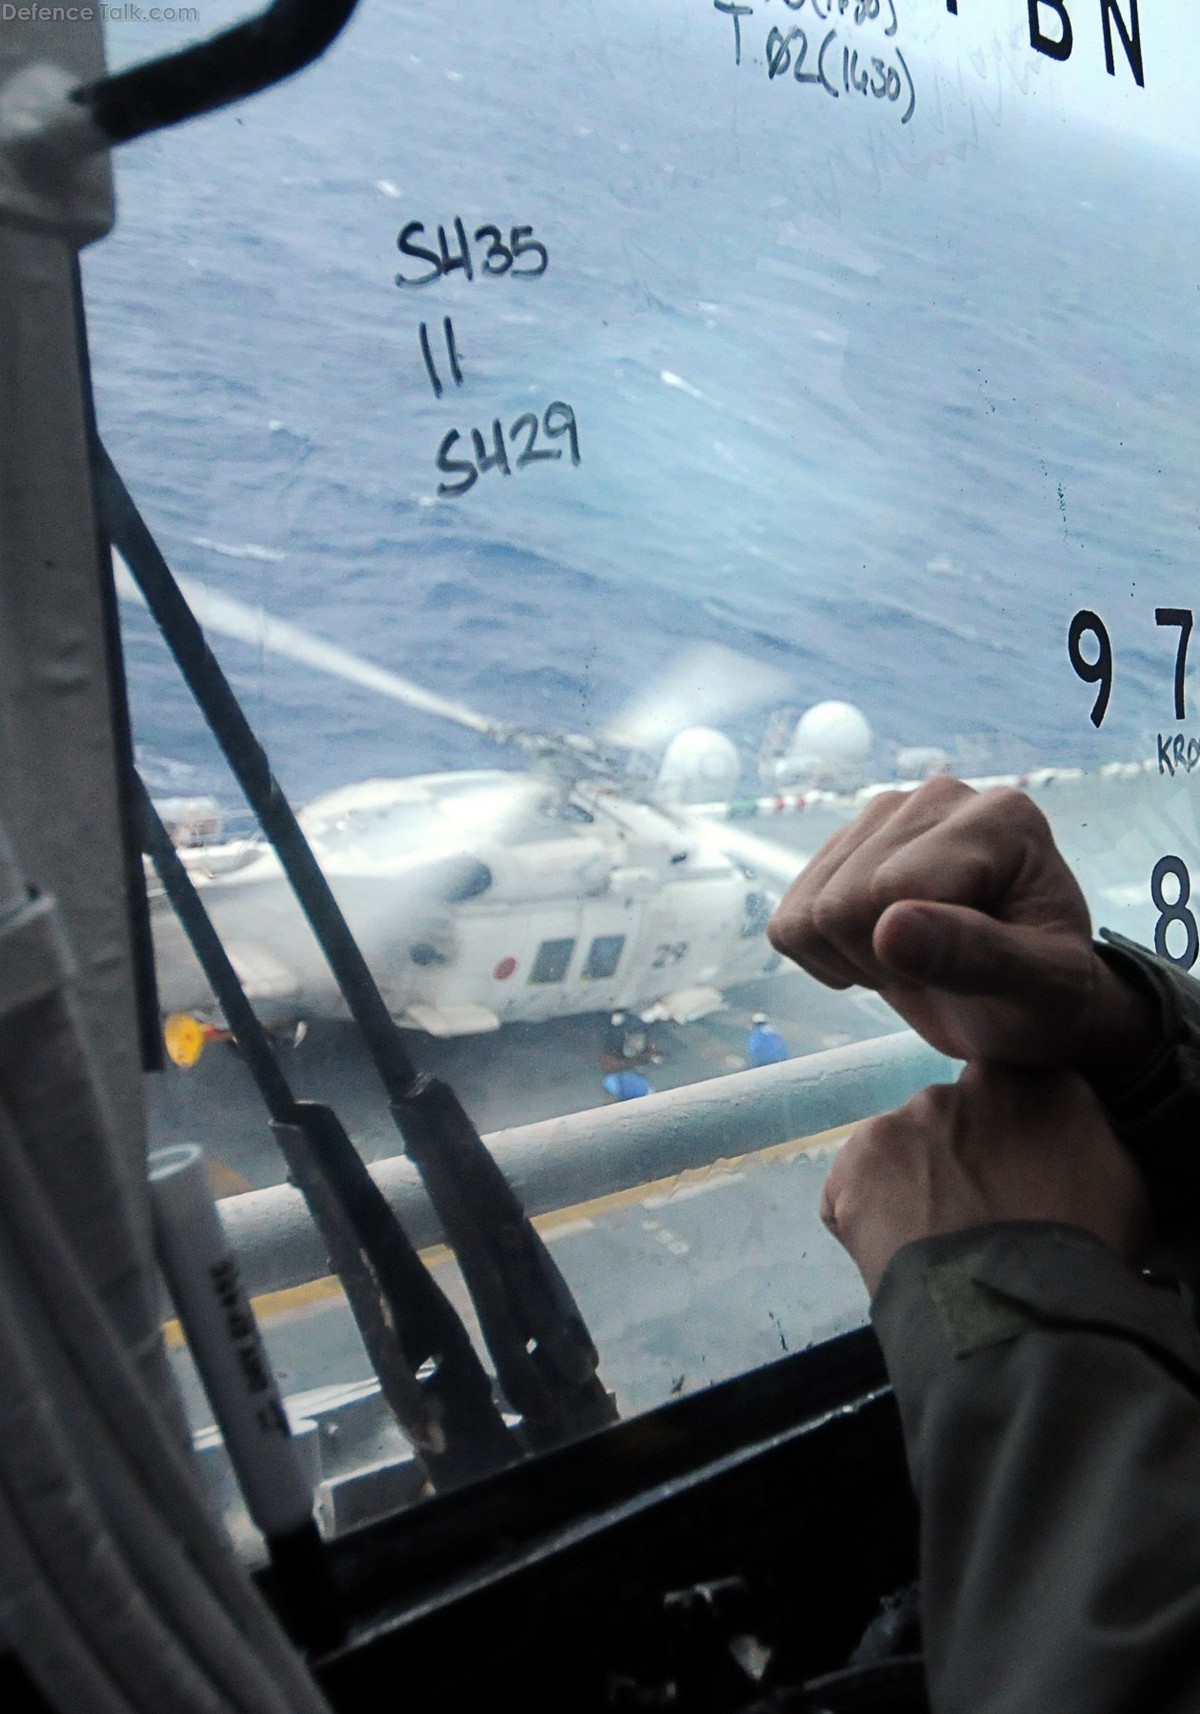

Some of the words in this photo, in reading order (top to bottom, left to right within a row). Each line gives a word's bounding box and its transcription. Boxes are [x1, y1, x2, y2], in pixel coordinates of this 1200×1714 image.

[436, 401, 581, 497] SH29
[1068, 609, 1113, 728] 9
[1155, 608, 1193, 720] 7
[1150, 854, 1200, 974] 8
